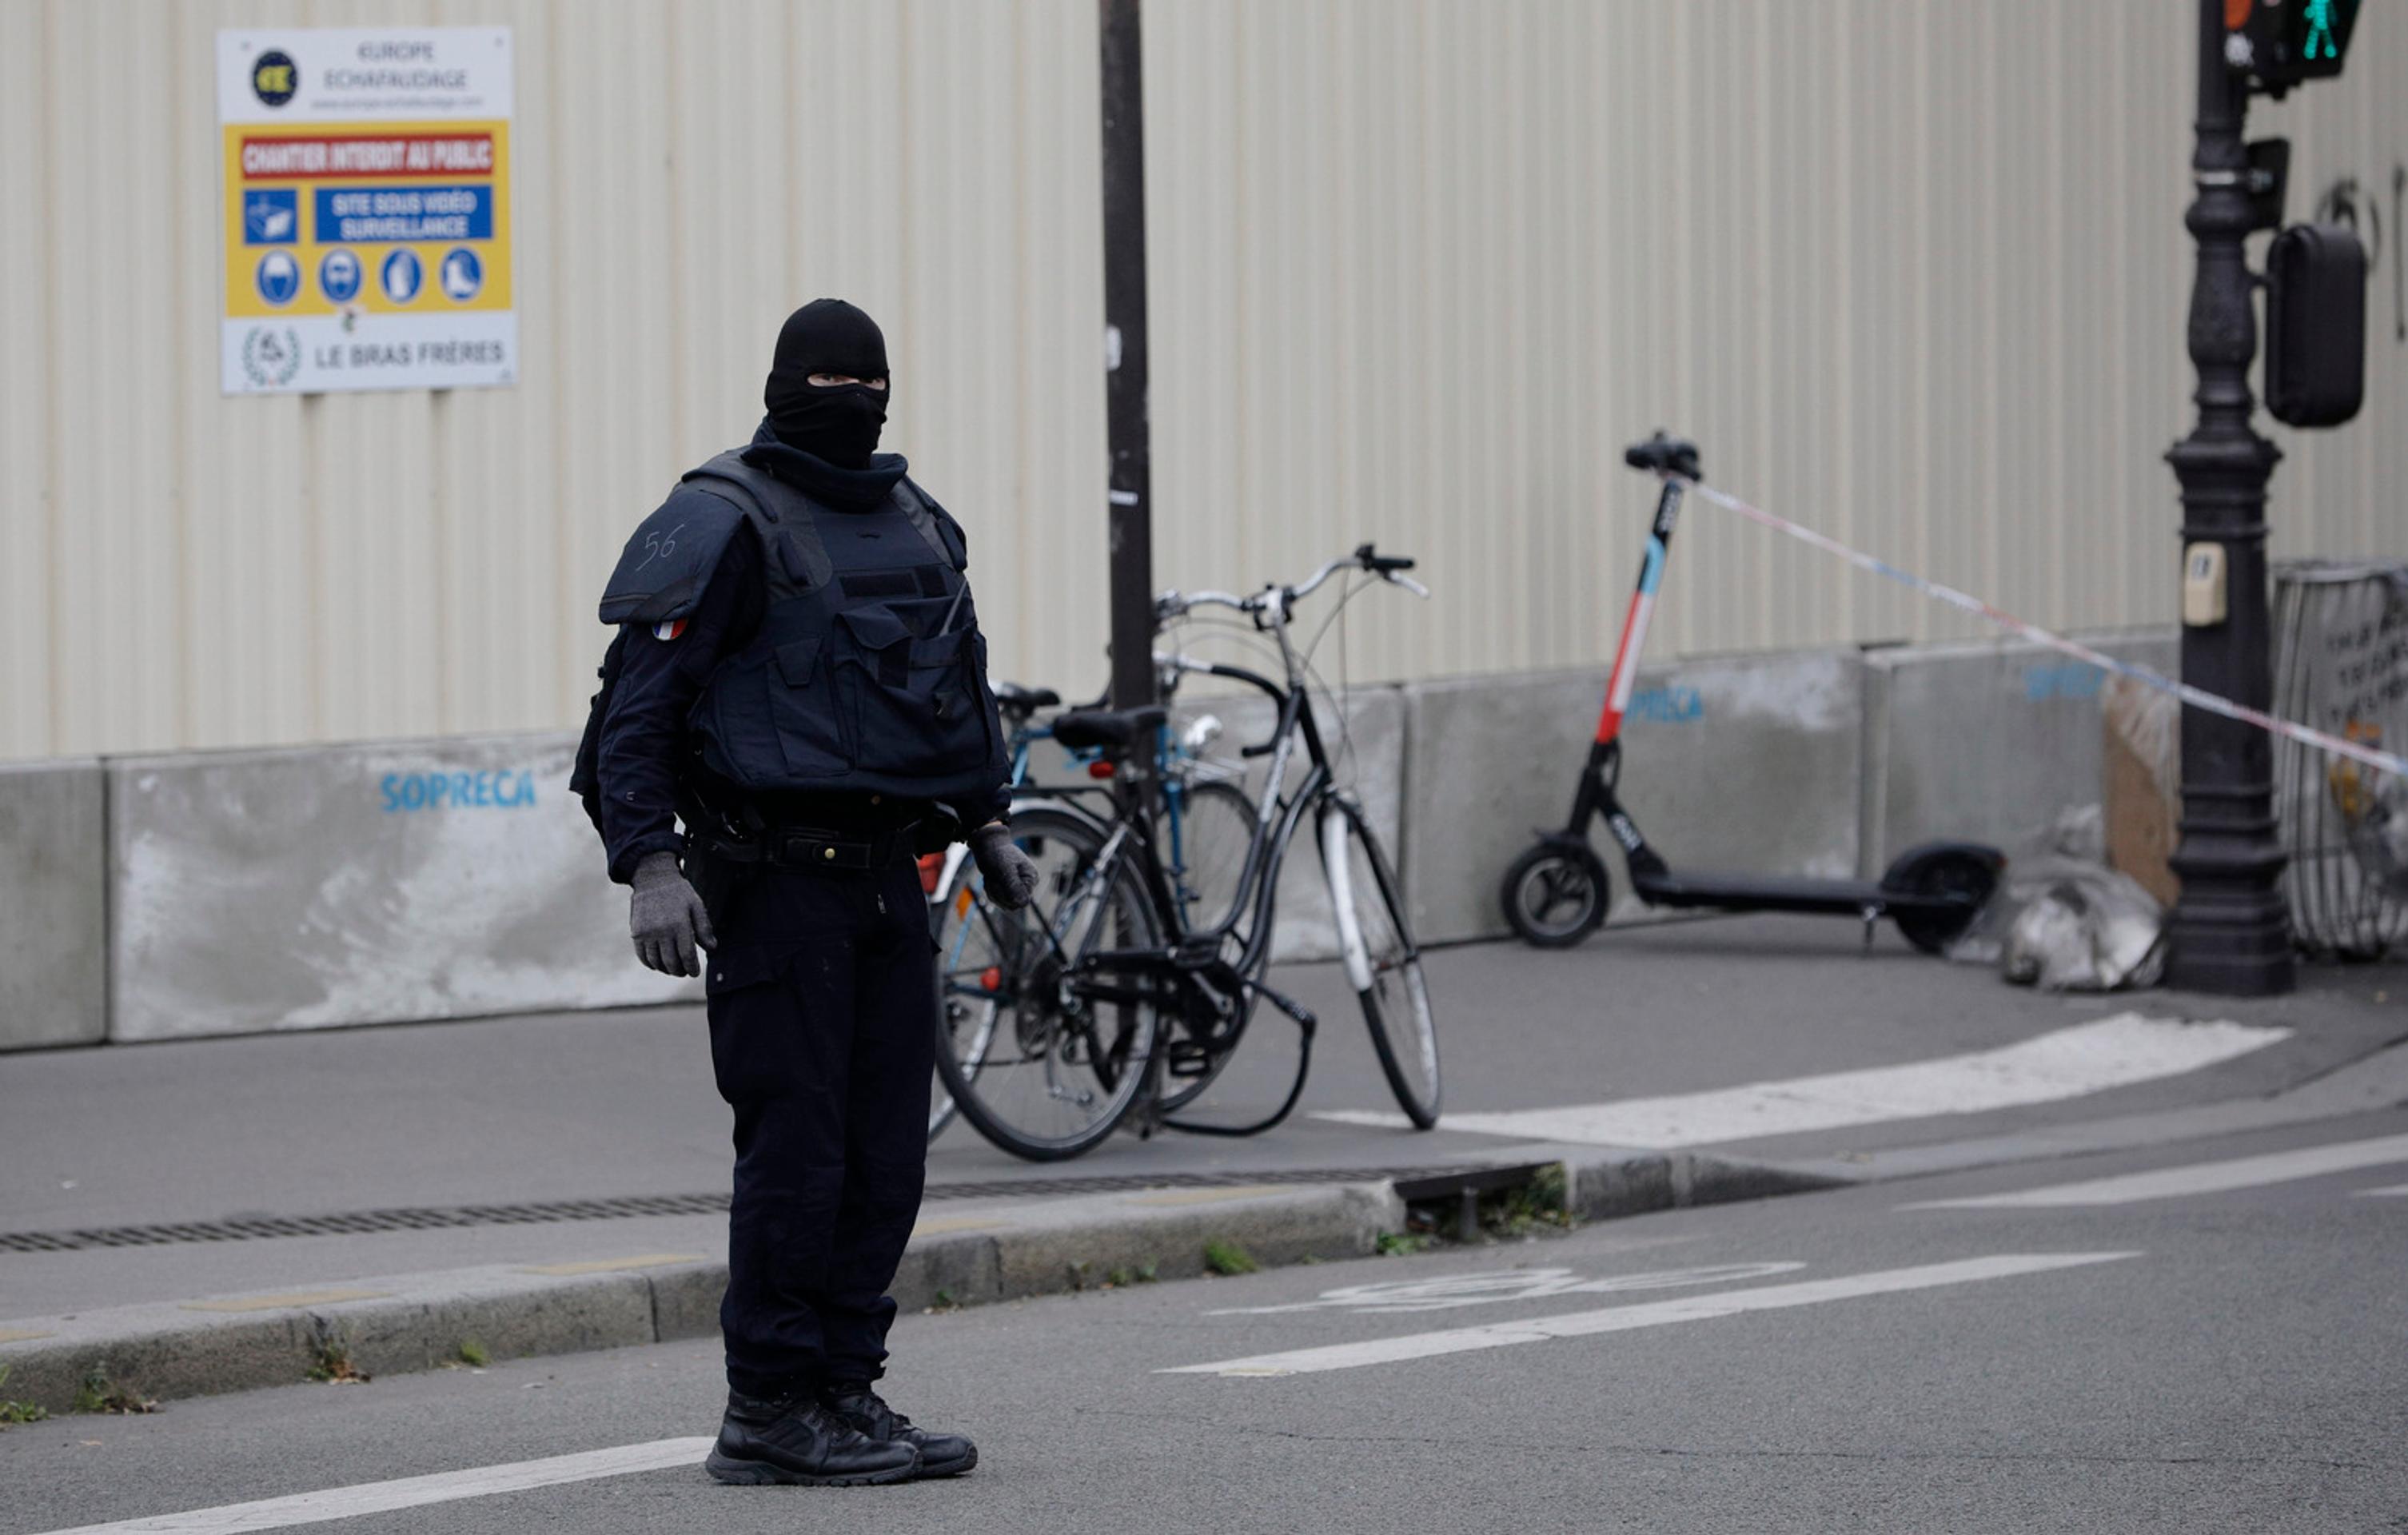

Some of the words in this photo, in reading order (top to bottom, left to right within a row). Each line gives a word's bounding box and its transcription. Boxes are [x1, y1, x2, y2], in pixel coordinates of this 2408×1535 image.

[358, 42, 433, 61] EUROPE
[244, 143, 327, 173] CHANTIER
[332, 142, 405, 170] INTERDIT
[407, 140, 430, 169] AU
[433, 140, 492, 169] PUBLIC
[333, 193, 371, 216] SITE
[373, 192, 421, 216] SOUS
[424, 188, 477, 213] VIDÉO
[341, 217, 468, 239] SURVEILLANCE
[315, 345, 342, 369] LE
[349, 343, 412, 368] BRAS
[418, 337, 504, 365] FRÈRES
[636, 524, 685, 572] 56
[381, 770, 536, 812] SOPRECA
